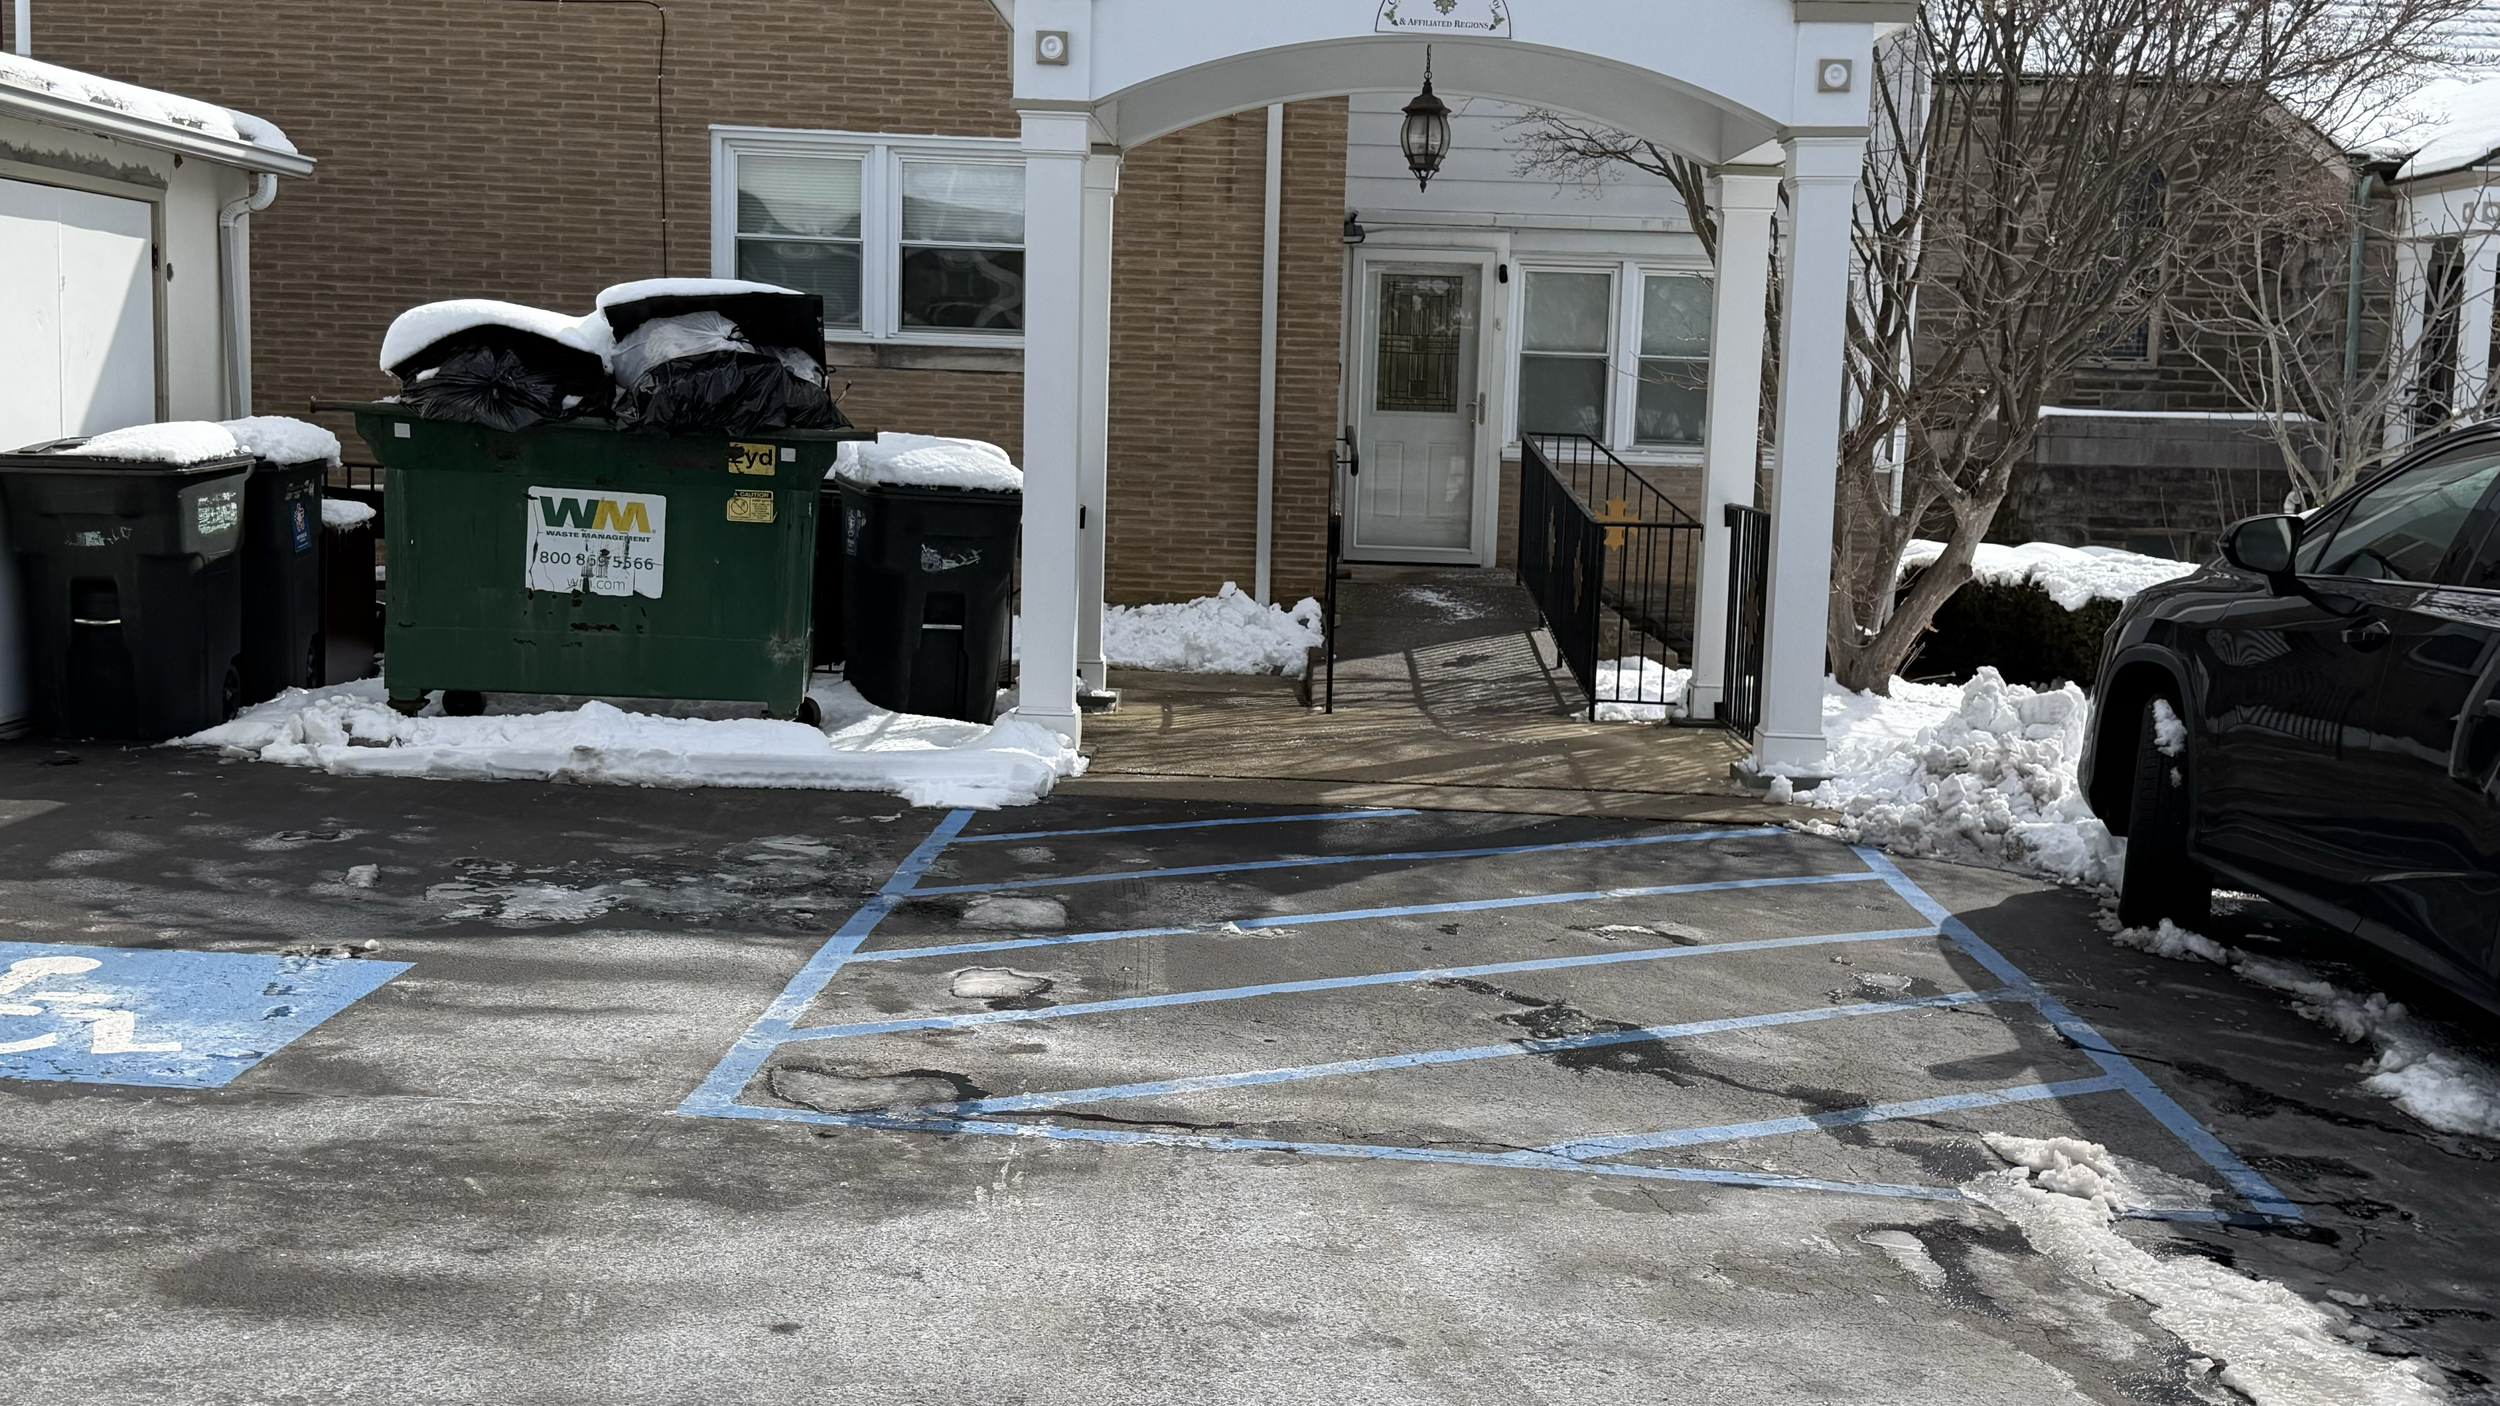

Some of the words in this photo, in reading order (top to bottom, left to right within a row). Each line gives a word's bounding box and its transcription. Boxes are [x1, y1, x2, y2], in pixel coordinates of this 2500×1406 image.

[1399, 17, 1406, 26] &
[1407, 18, 1453, 28] AFFILIATED
[1454, 19, 1489, 30] REGIONS
[739, 491, 770, 499] CAUTION
[539, 495, 652, 534] WM
[545, 529, 580, 539] WASTE
[581, 532, 652, 543] MANAGEMENT
[539, 550, 571, 565] 800
[612, 555, 655, 571] 5566
